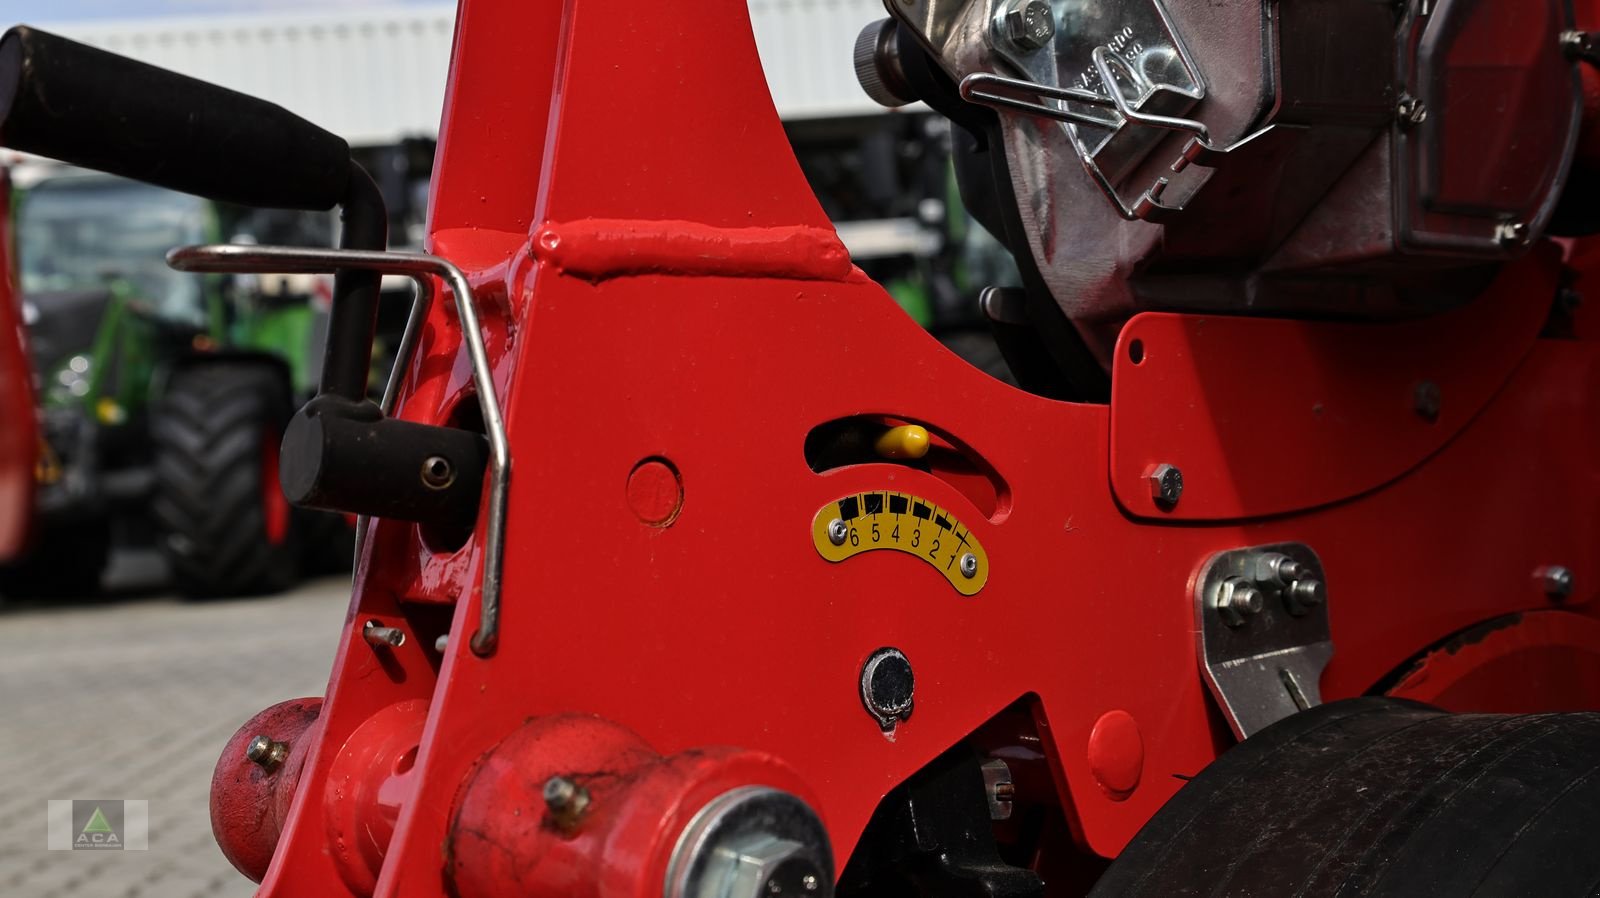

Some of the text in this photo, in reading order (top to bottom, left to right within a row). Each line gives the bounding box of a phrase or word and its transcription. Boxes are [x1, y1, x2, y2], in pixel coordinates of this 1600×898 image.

[850, 524, 956, 570] 6 5 4 3 2 1
